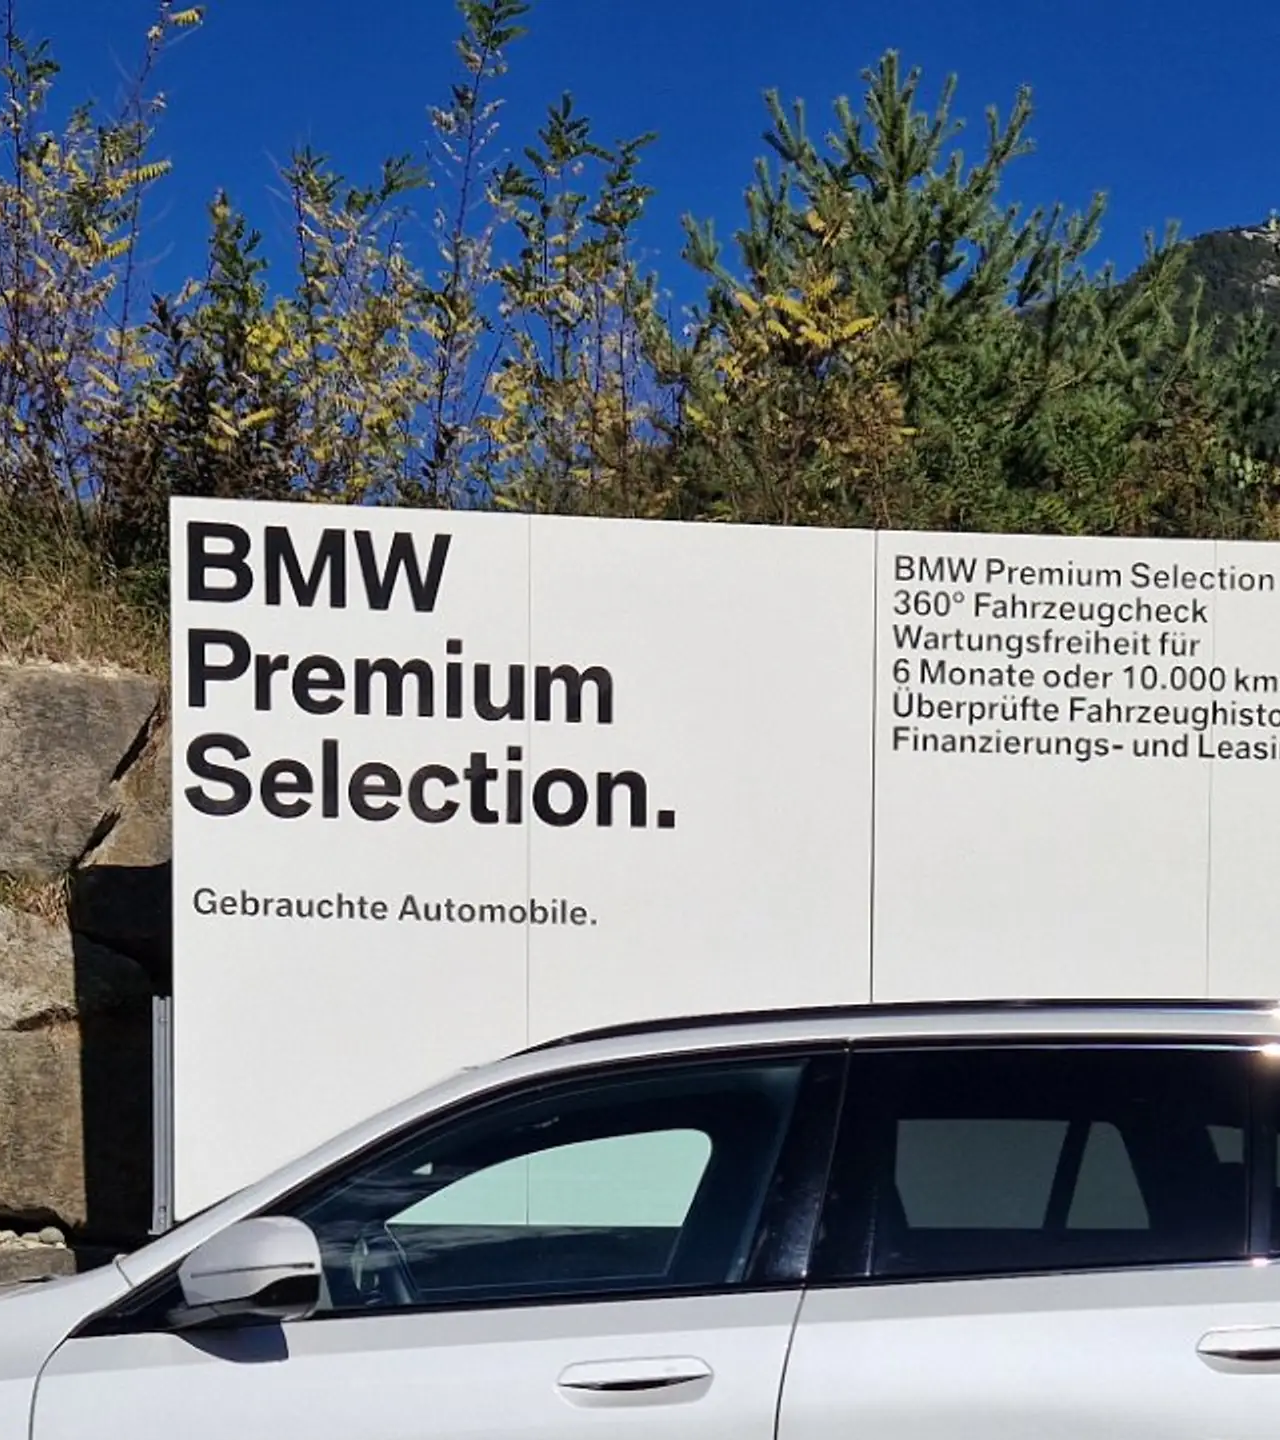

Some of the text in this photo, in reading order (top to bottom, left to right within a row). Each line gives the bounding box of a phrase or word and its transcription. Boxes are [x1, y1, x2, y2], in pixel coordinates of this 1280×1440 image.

[186, 520, 452, 613] BMW
[895, 555, 977, 583] BMW
[986, 558, 1122, 587] Premium
[1131, 562, 1274, 593] Selection
[893, 589, 1208, 628] 360° Fahrzeugcheck
[893, 624, 1200, 659] Wartungsfreiheit für
[187, 628, 613, 725] Premium
[893, 658, 1278, 693] 6 Monate oder 10.000 km
[893, 686, 1059, 726] Überprüfte
[893, 726, 1124, 763] Finanzierungs-
[1133, 733, 1189, 759] und
[184, 732, 676, 829] Selection.
[193, 887, 598, 926] Gebrauchte Automobile.
